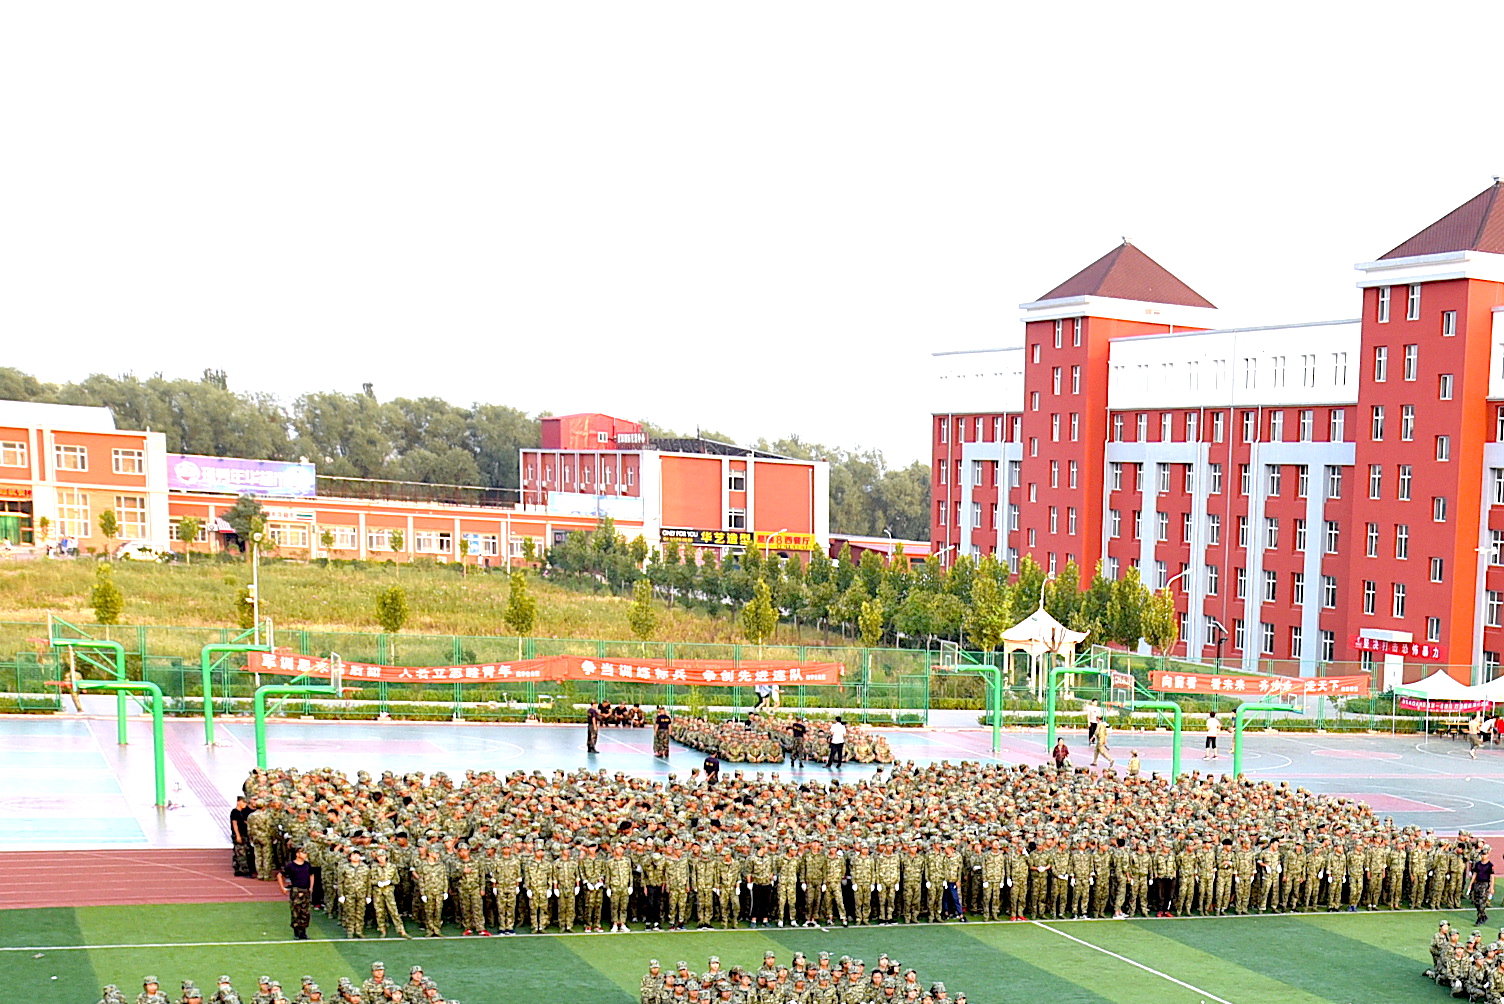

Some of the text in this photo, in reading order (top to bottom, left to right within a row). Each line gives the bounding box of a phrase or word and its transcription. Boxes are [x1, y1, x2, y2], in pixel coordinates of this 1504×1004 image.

[701, 531, 751, 545] 华艺造型
[580, 659, 687, 682] 争当训练标兵
[1161, 674, 1197, 690] 向前看
[1211, 678, 1246, 691] 看未来
